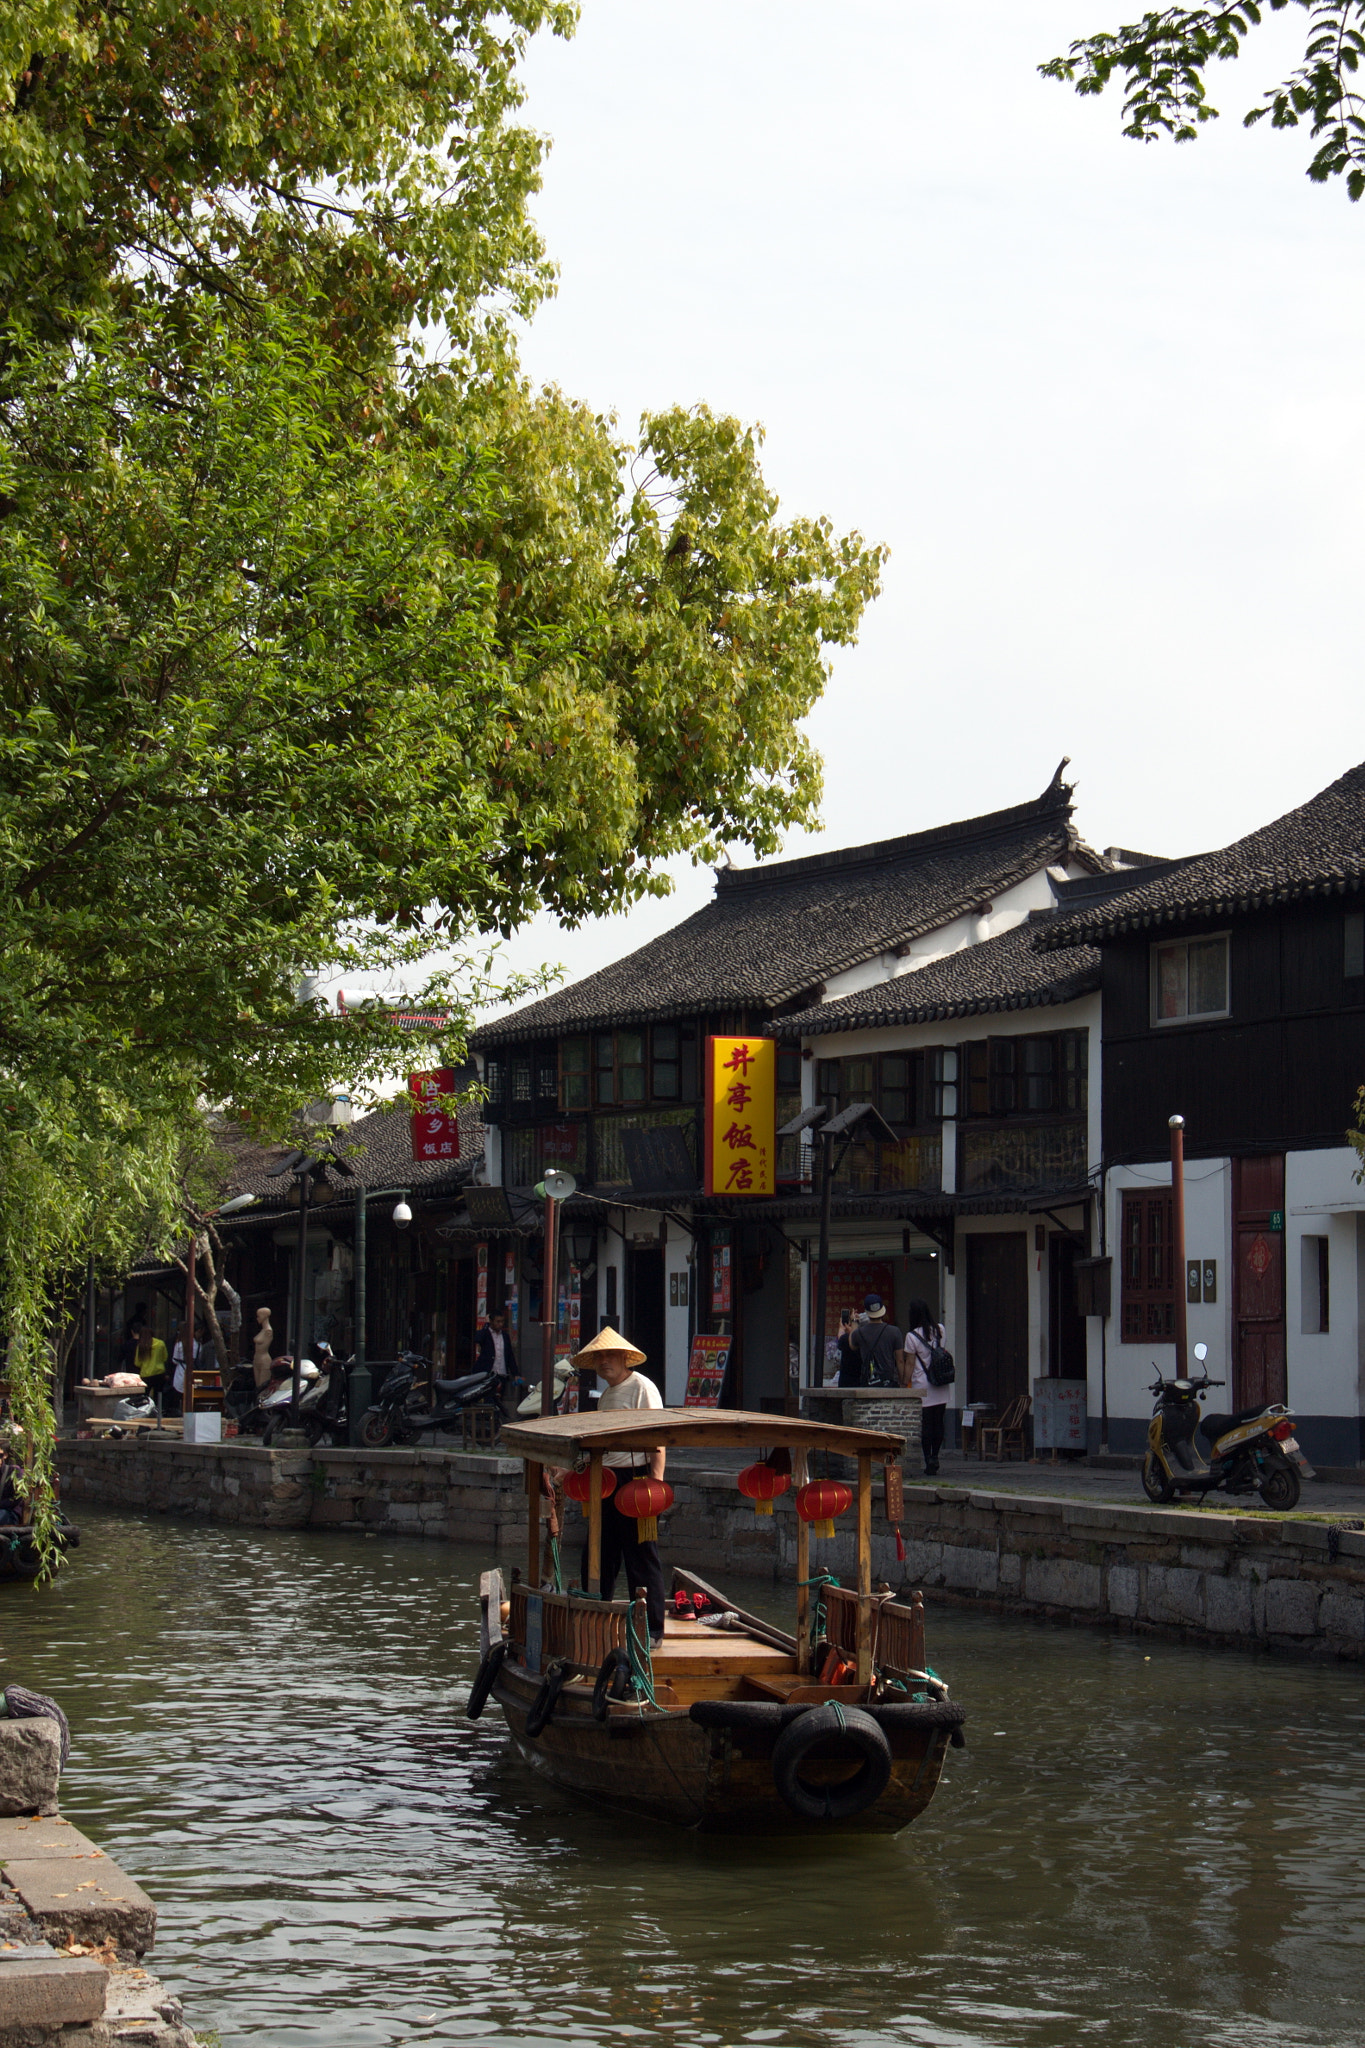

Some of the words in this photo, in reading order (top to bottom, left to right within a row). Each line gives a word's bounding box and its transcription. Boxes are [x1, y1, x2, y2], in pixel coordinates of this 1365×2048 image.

[723, 1044, 757, 1190] 井亭饭店
[422, 1141, 453, 1155] 饭店
[1273, 1213, 1281, 1225] 65
